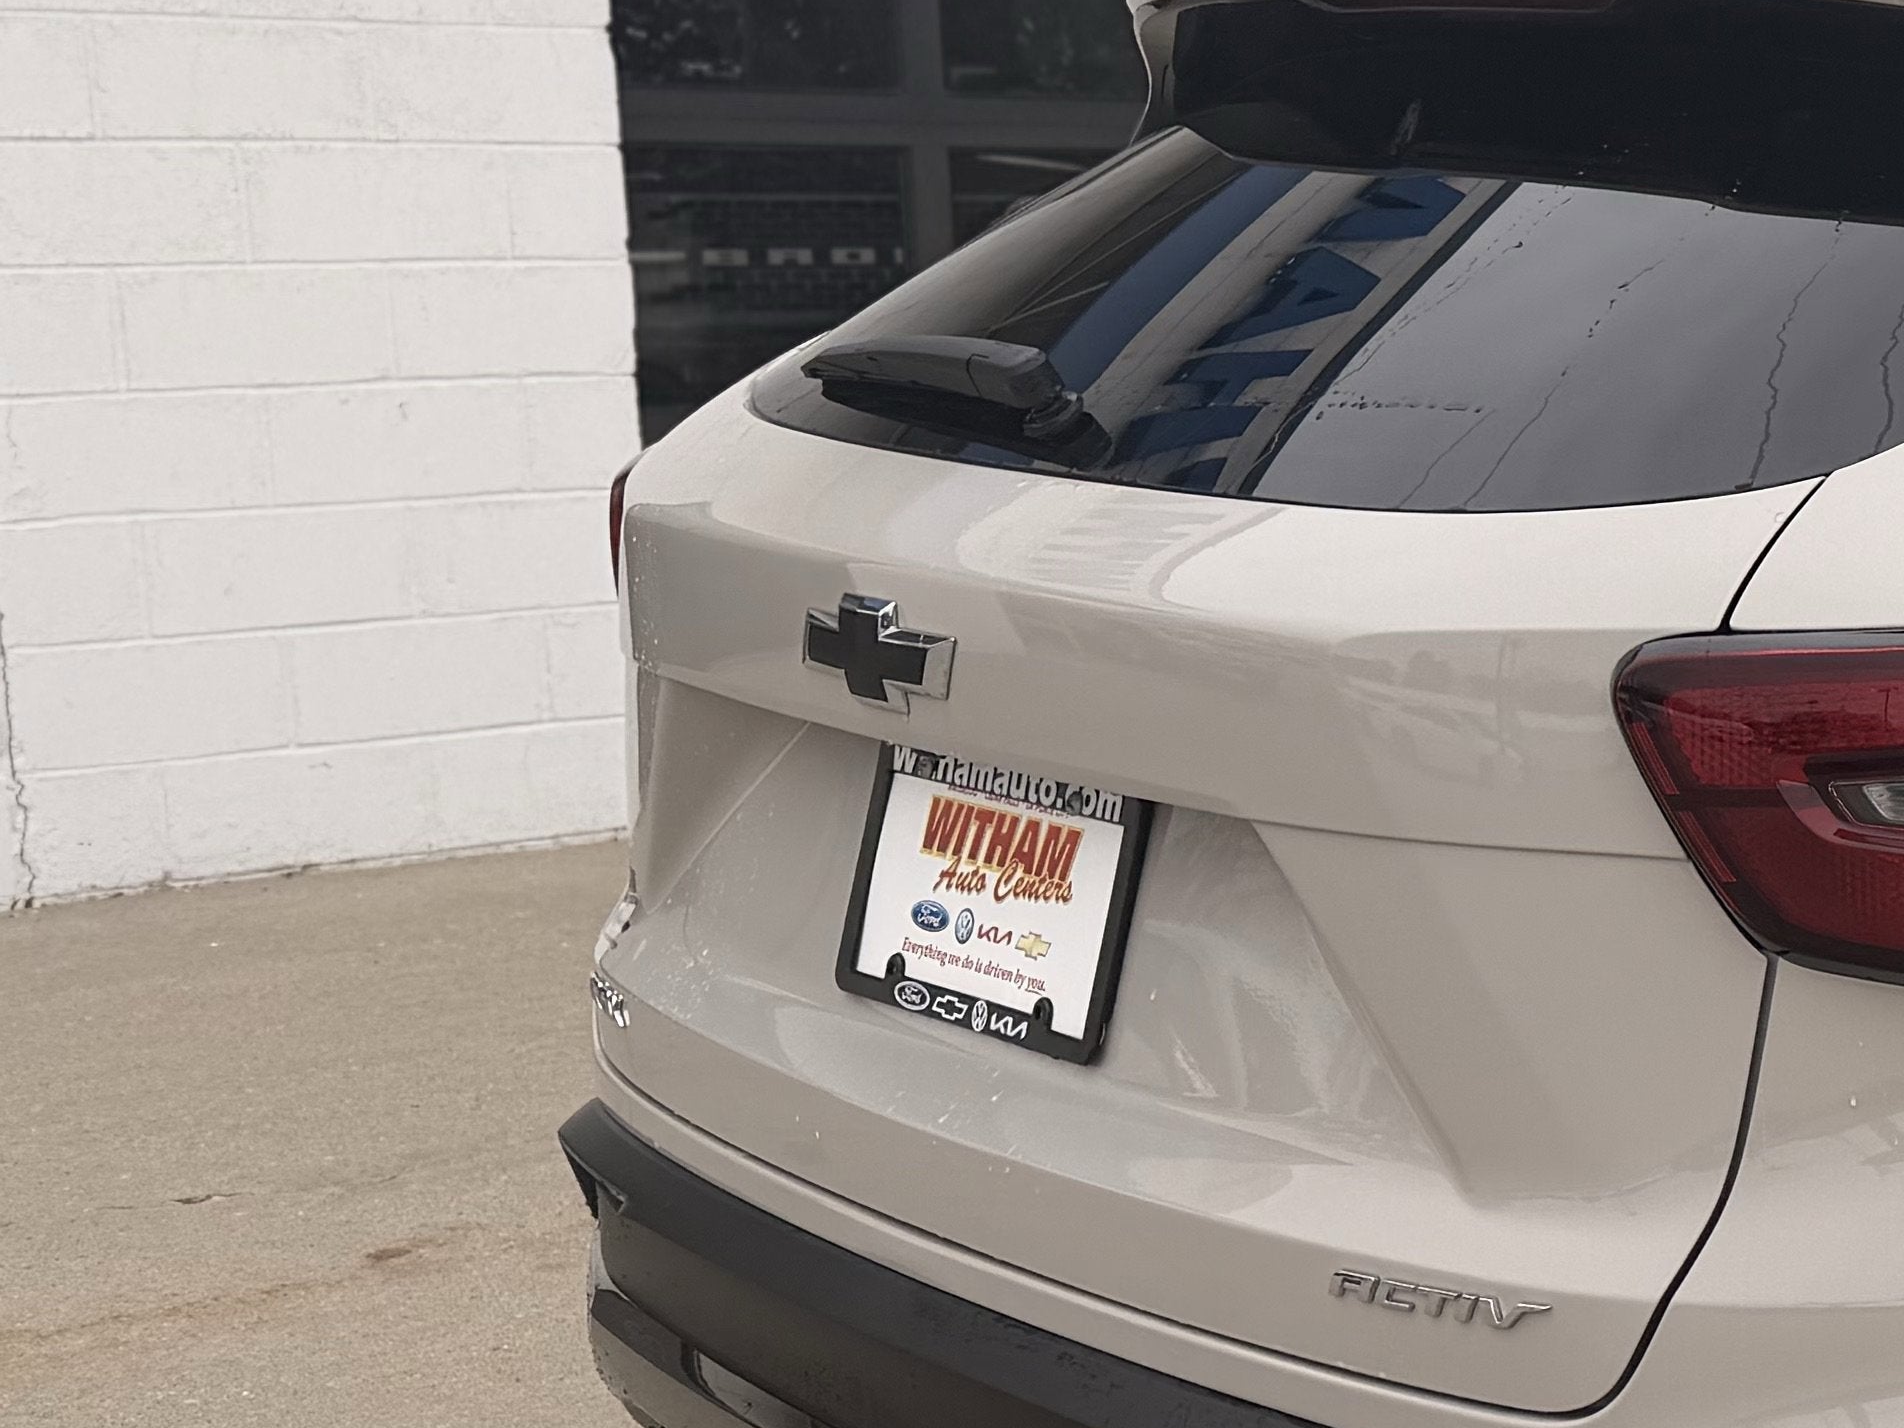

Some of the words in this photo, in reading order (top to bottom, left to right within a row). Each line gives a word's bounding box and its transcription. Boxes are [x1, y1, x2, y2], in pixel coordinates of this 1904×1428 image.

[893, 745, 1124, 822] whamauto.com
[921, 795, 1084, 883] WITHAM
[933, 857, 987, 895] Auto
[994, 860, 1073, 904] Centers
[902, 937, 946, 966] Everything
[948, 952, 961, 967] we
[962, 954, 974, 971] do
[983, 960, 1013, 983] driven
[1014, 969, 1027, 990] by
[1328, 1269, 1553, 1329] ACTIV
